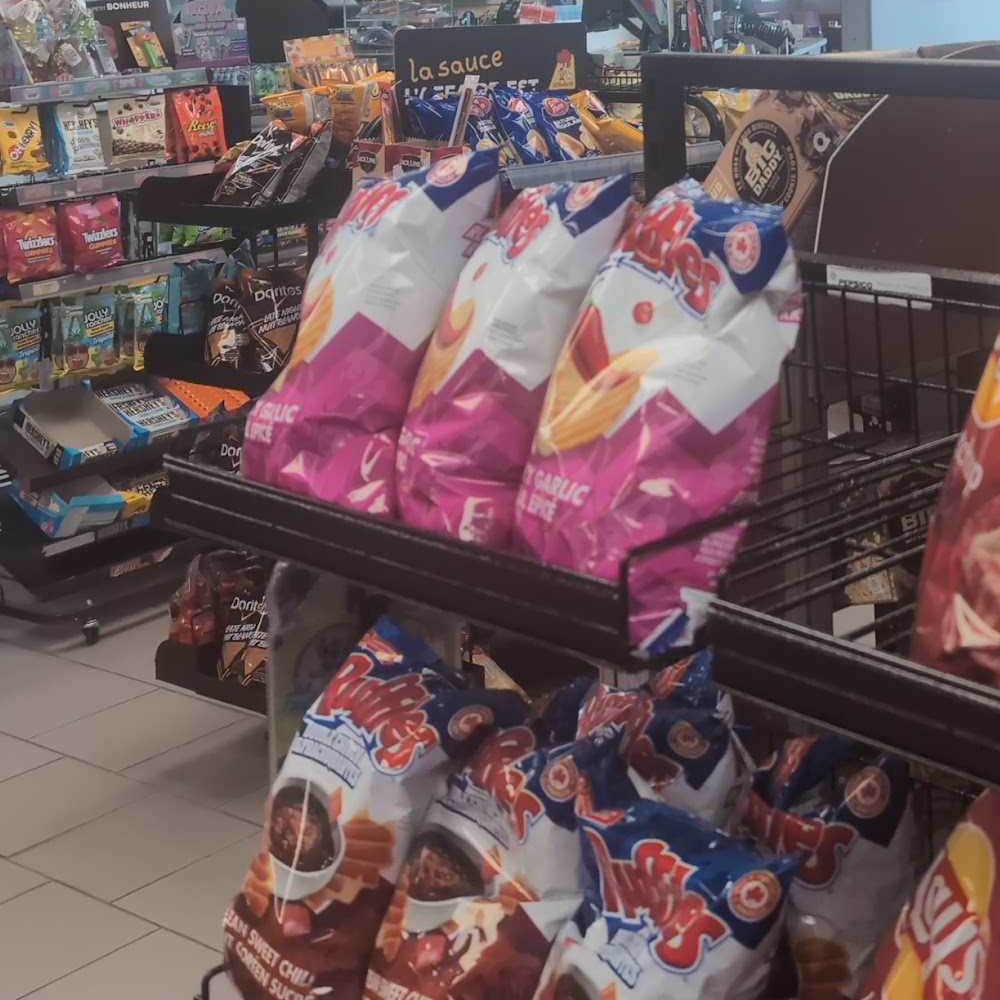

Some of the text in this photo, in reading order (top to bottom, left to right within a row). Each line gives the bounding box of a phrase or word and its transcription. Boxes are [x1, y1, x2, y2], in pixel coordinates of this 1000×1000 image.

[106, 1, 150, 11] BONHEUR
[408, 50, 503, 83] la sauce
[113, 111, 162, 127] WHOPPERS
[9, 120, 40, 159] OH HENRY!
[744, 138, 778, 188] BIG
[752, 148, 783, 197] DADDY
[16, 235, 55, 250] Twizzlers
[82, 227, 119, 243] Twizzlers
[254, 285, 302, 302] Doritos
[83, 307, 110, 323] JOLLY
[85, 315, 113, 329] rancher
[10, 319, 37, 337] JOLLY
[534, 469, 592, 506] GARLIC
[247, 928, 281, 968] SWEET
